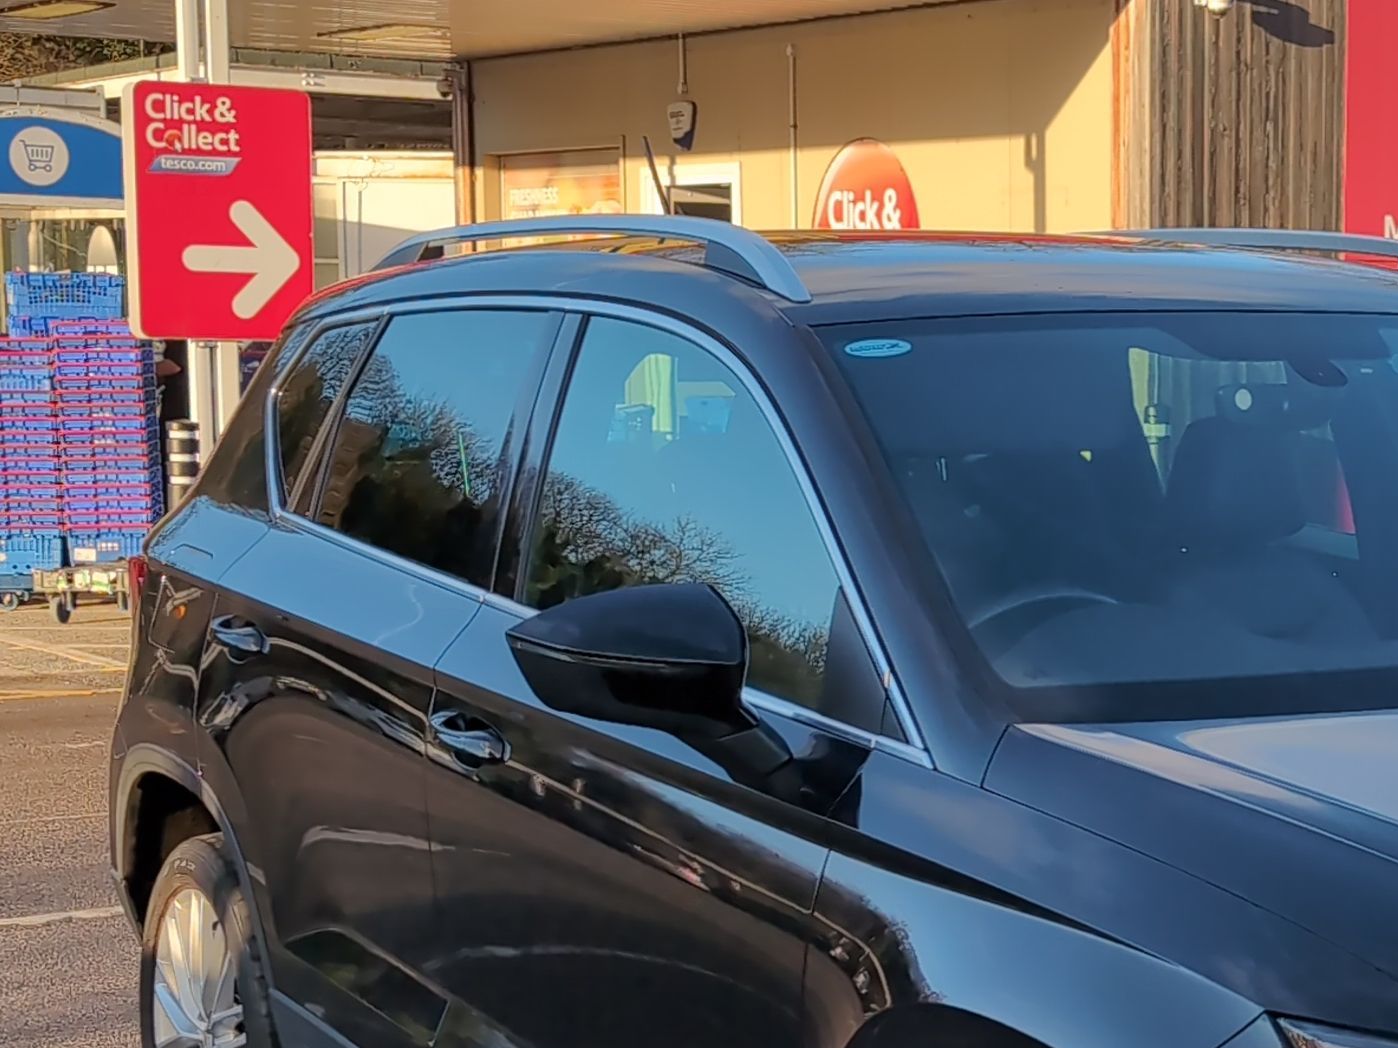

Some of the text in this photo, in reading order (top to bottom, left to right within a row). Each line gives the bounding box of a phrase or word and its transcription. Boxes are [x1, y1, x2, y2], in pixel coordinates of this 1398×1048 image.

[144, 92, 237, 123] Click &
[145, 121, 241, 152] Collect
[160, 157, 226, 172] tesco.com
[827, 187, 902, 230] Click &
